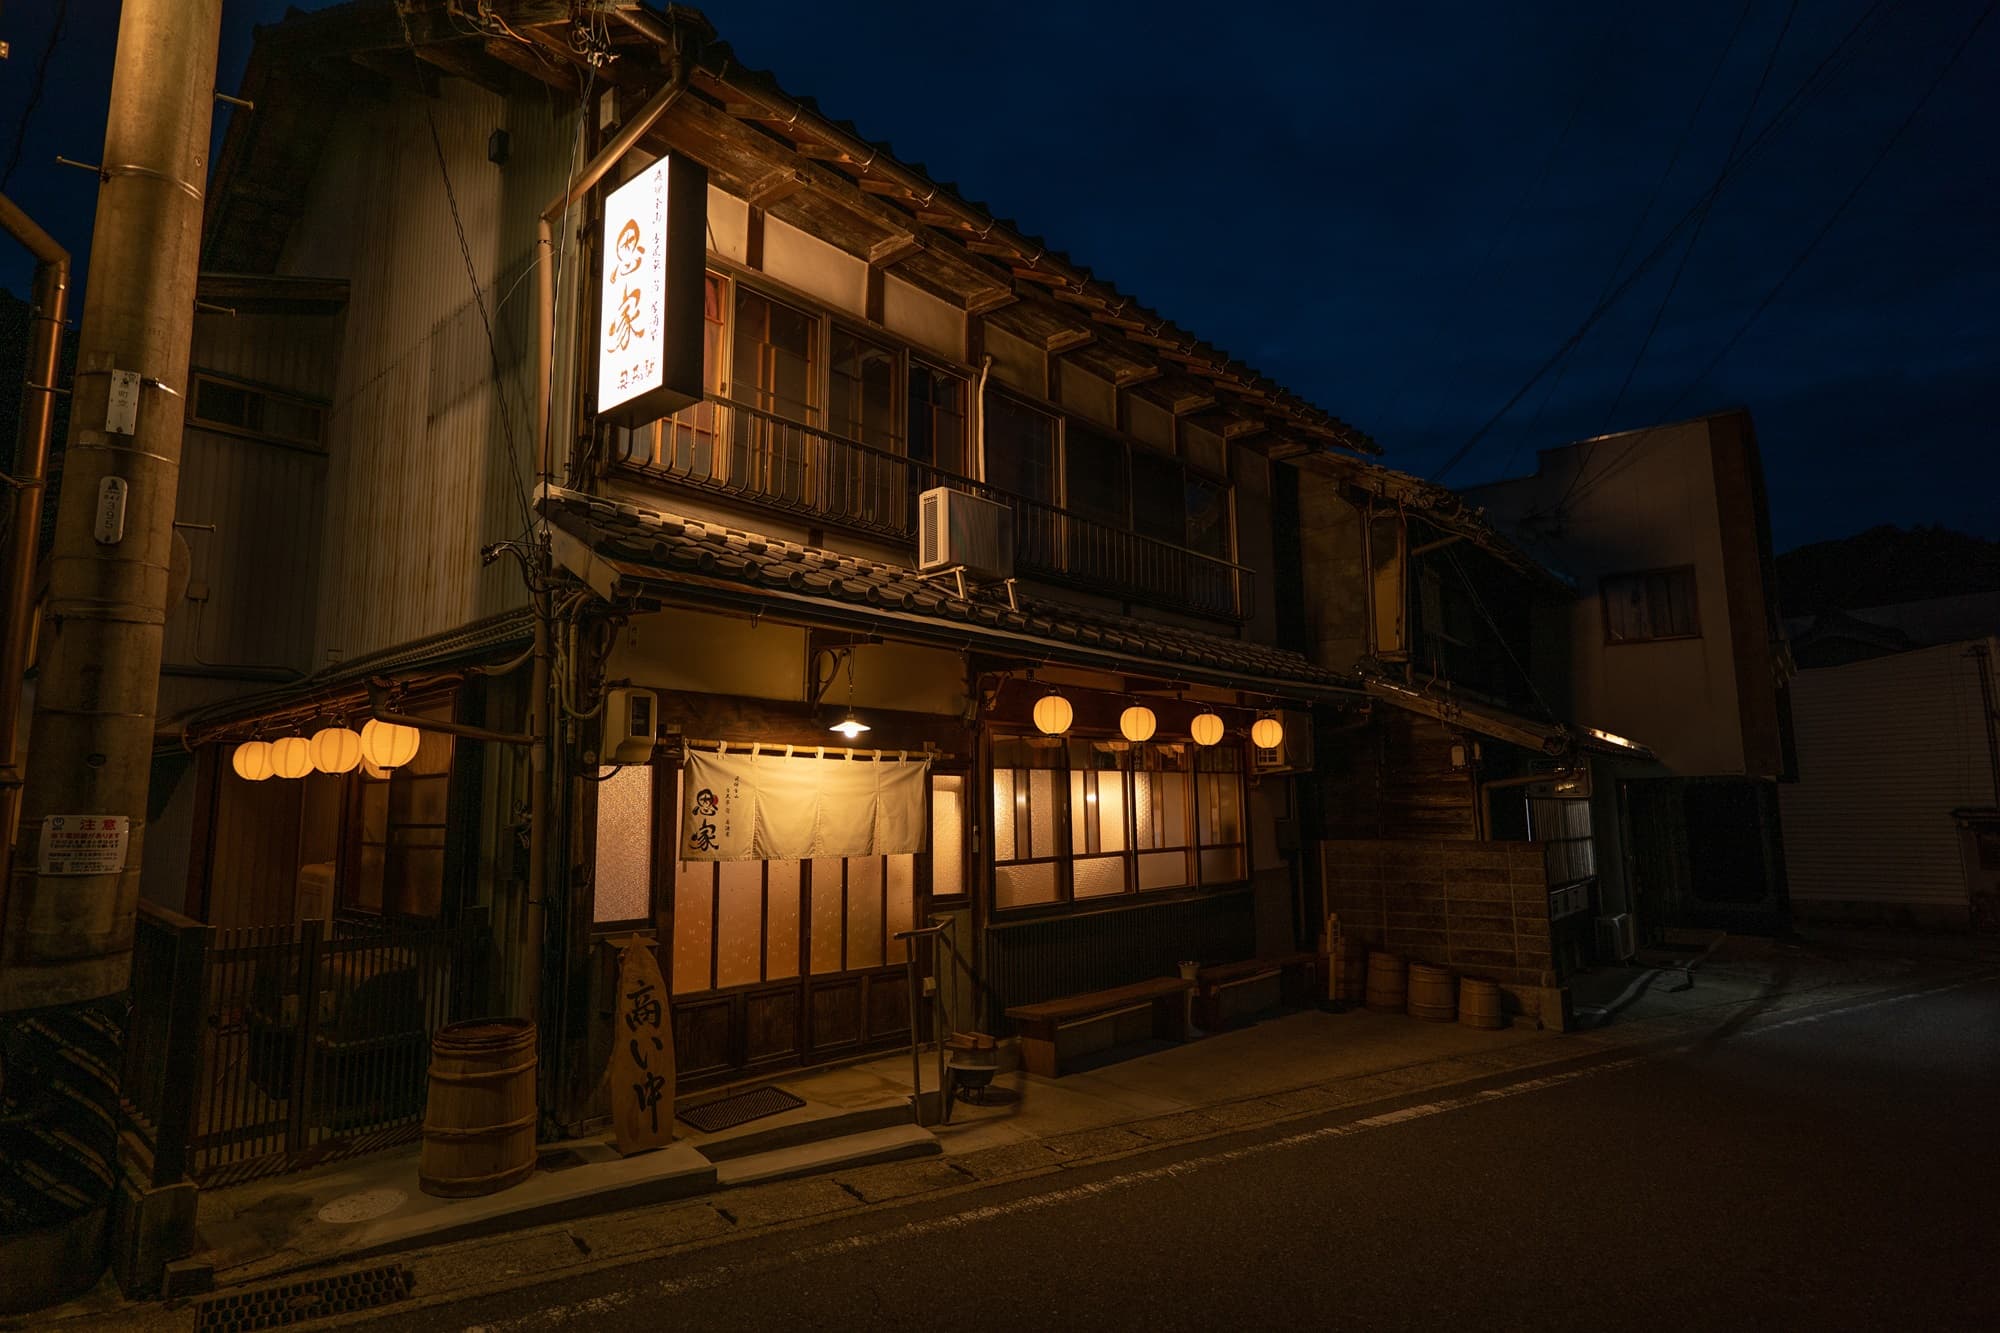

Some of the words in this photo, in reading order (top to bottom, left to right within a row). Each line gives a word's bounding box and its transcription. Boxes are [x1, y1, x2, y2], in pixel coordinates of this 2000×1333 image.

[80, 818, 116, 831] 注意
[624, 979, 666, 1135] 商い中
